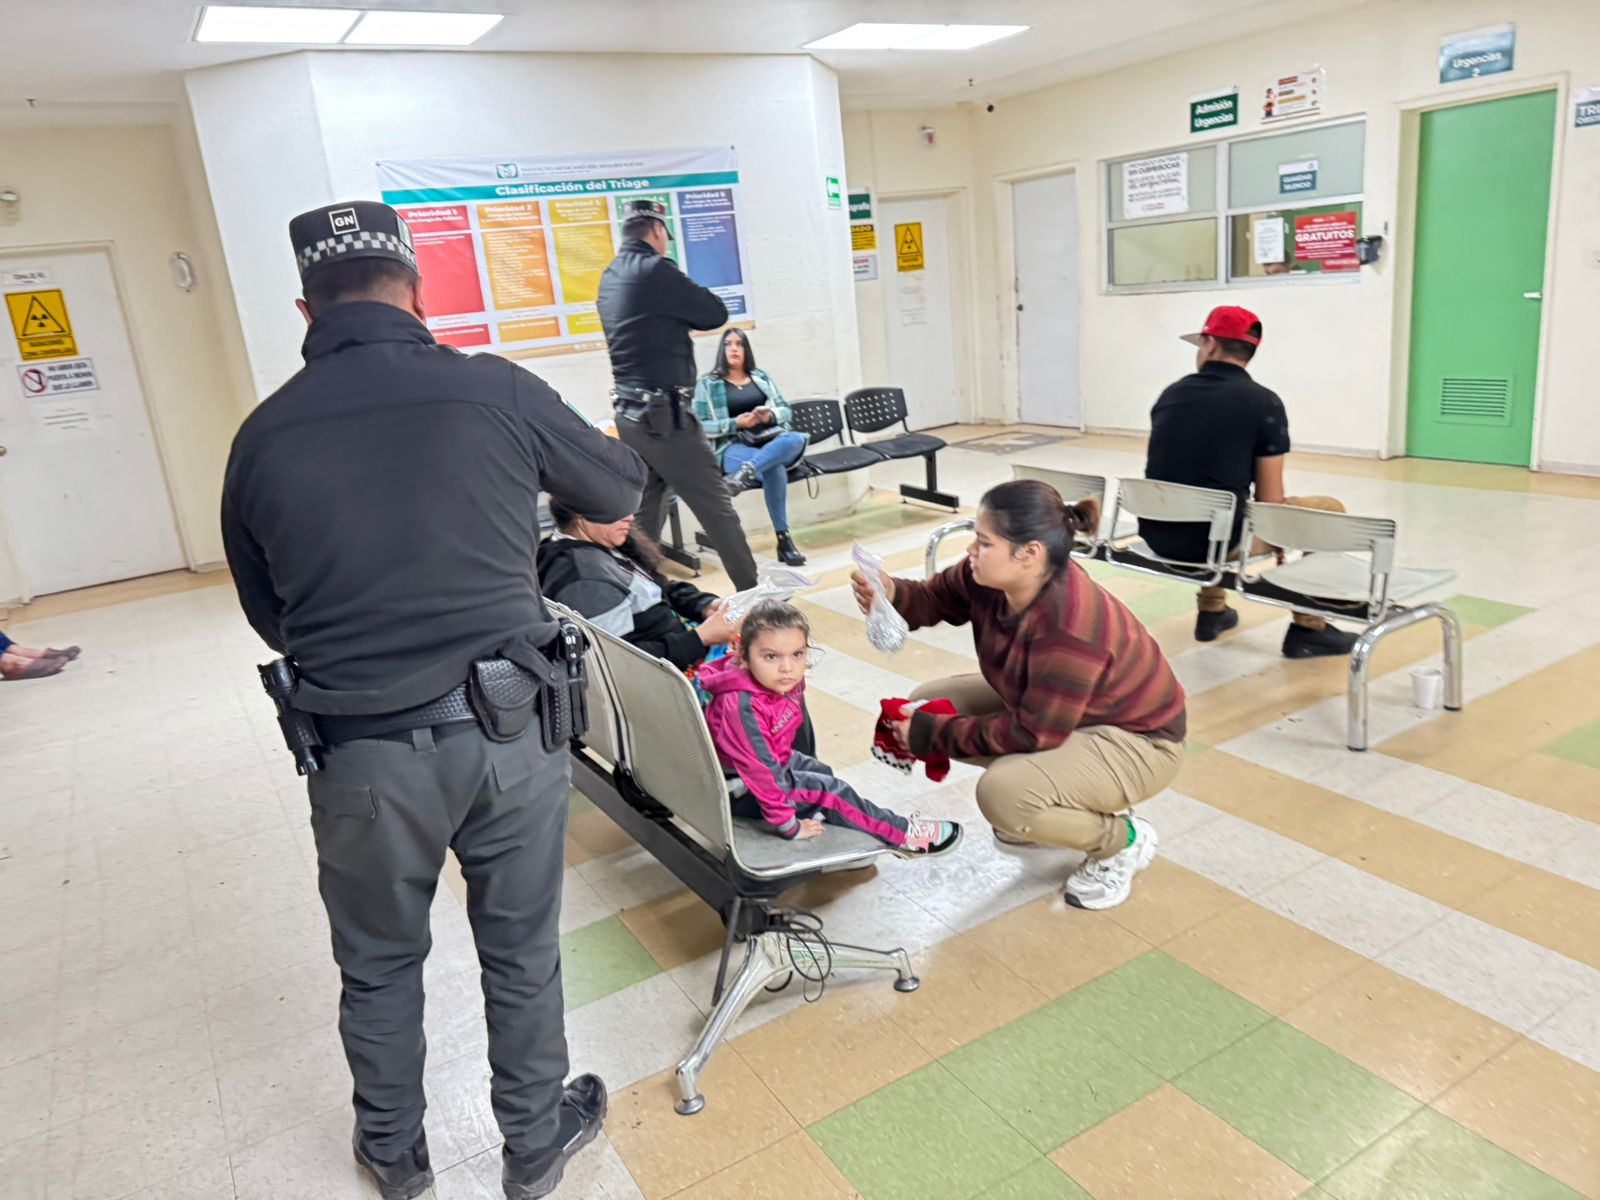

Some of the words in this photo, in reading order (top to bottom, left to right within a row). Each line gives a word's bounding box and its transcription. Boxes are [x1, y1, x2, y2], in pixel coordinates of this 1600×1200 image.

[1195, 99, 1233, 115] Admisión
[1194, 113, 1234, 128] Urgencias
[495, 181, 584, 196] Clasificación
[586, 179, 607, 191] del
[608, 178, 650, 190] Triage
[407, 209, 452, 218] Prioridad
[334, 215, 355, 227] GN
[1295, 229, 1355, 242] GRATUITOS
